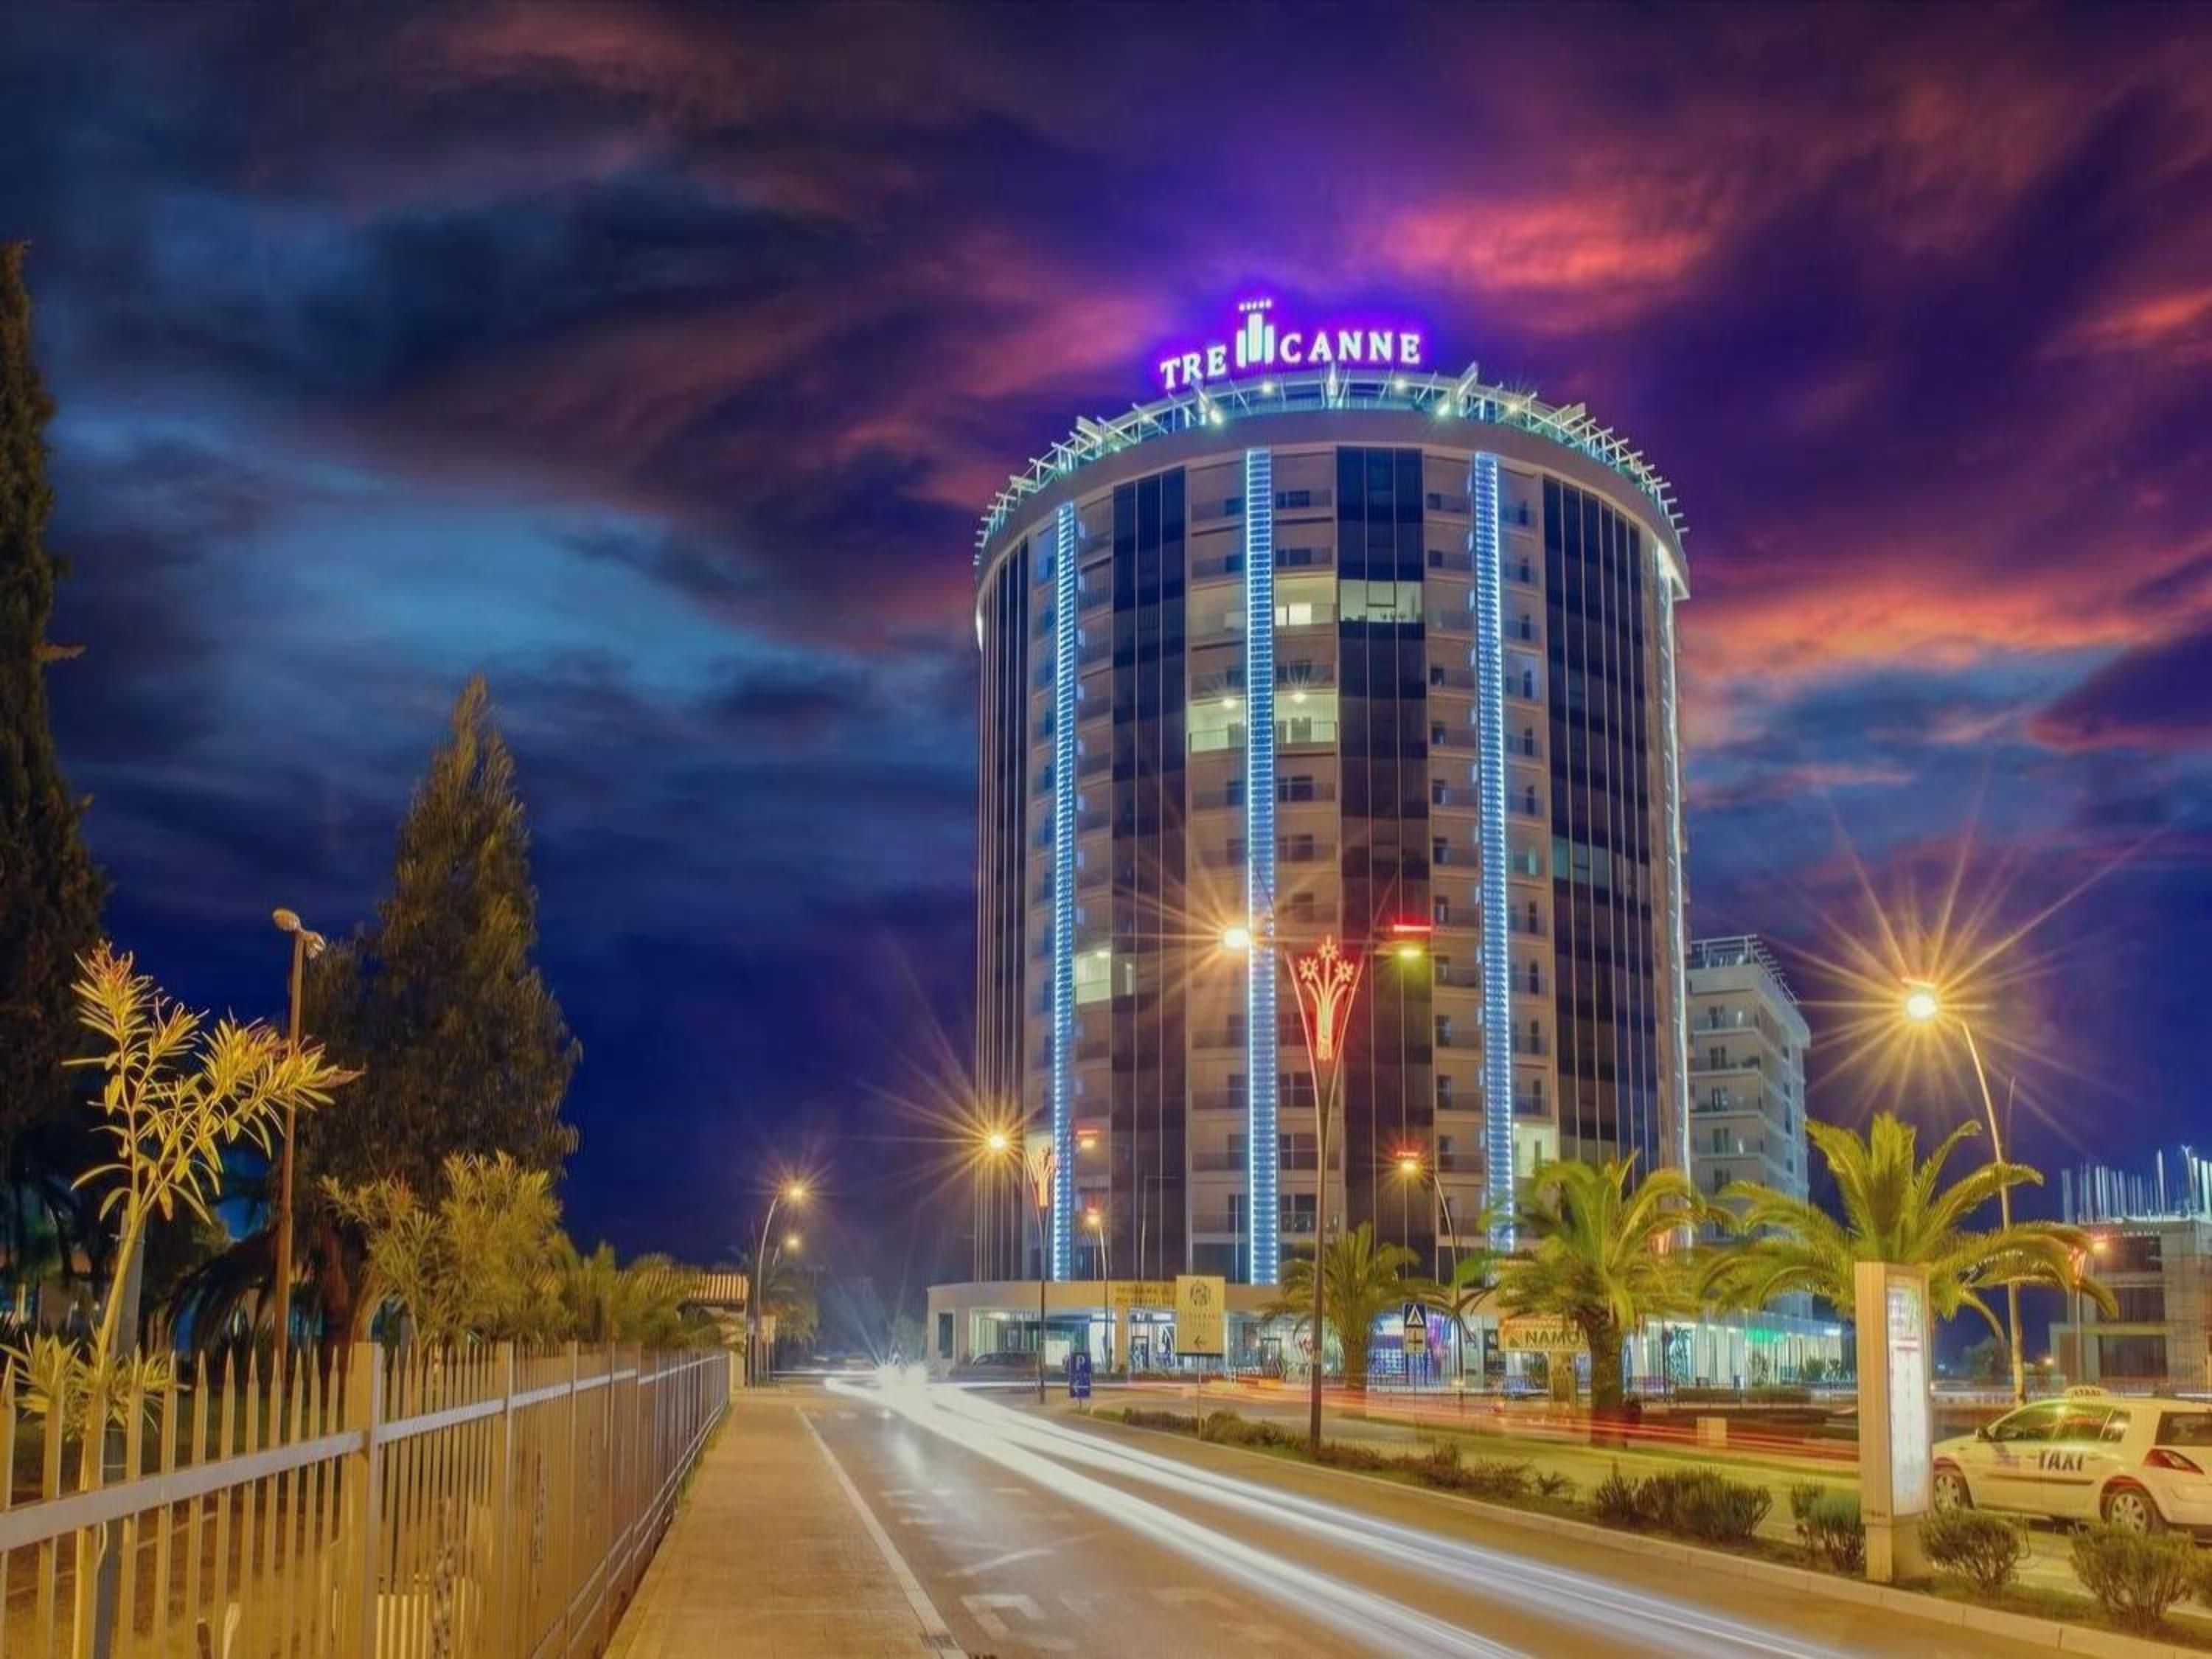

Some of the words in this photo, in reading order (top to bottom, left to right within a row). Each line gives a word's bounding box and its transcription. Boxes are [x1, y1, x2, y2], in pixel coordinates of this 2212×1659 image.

[1160, 345, 1227, 389] TRE
[1279, 330, 1420, 364] CANNE
[1525, 1330, 1586, 1346] NAMO
[1076, 1355, 1086, 1371] P
[2038, 1450, 2084, 1471] TAXI
